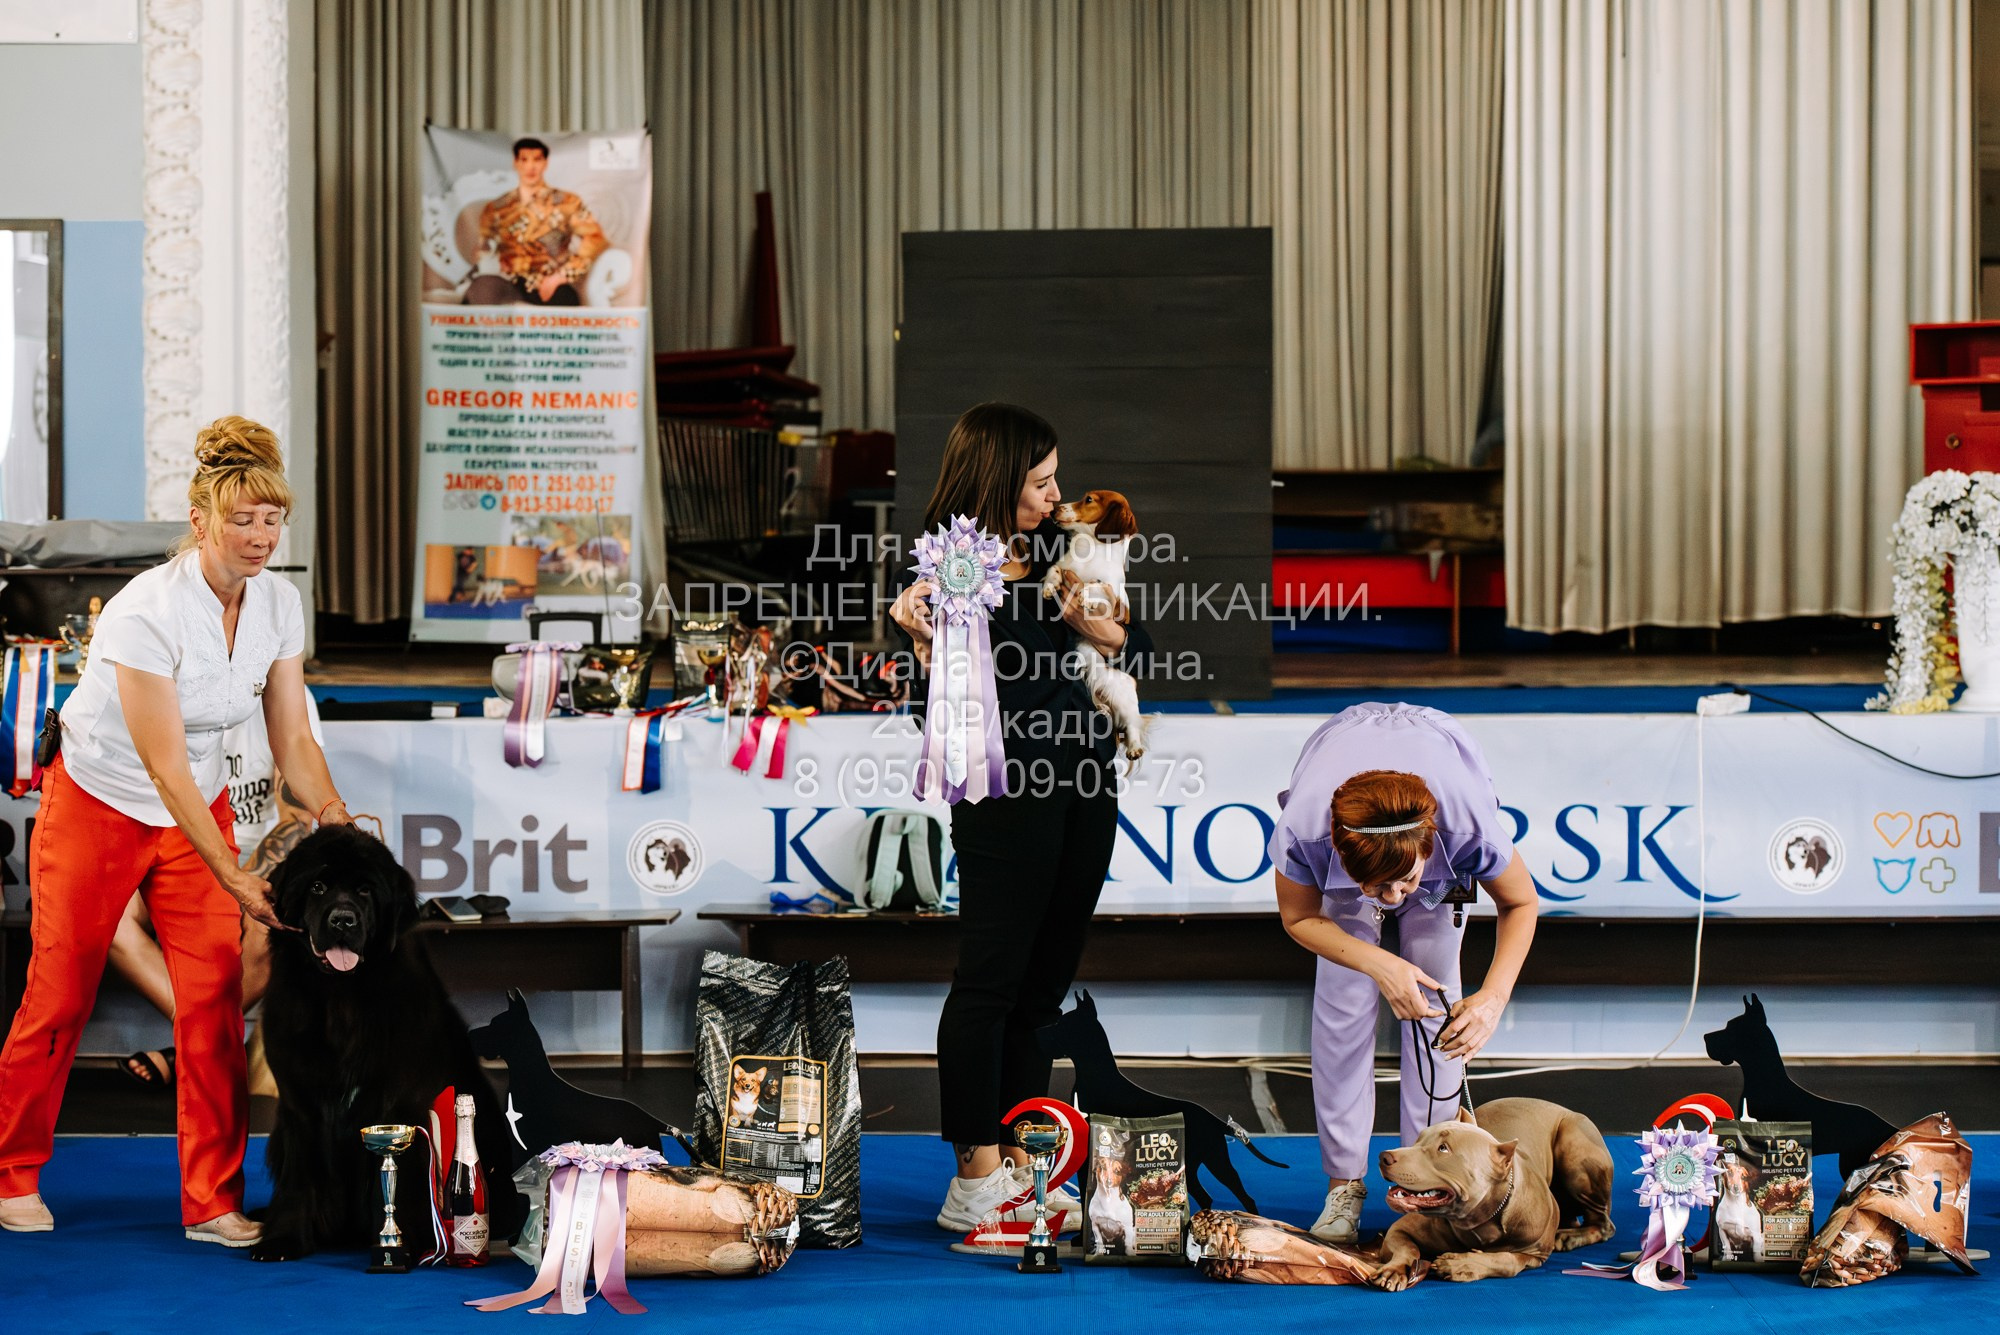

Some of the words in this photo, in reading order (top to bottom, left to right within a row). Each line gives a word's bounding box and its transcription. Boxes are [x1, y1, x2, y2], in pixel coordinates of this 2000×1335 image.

[426, 388, 523, 409] GREGOR
[532, 391, 638, 410] NEMANIC
[444, 473, 503, 490] ЗАПИСЬ
[508, 475, 527, 491] ПО
[548, 475, 615, 492] 251-03-17
[501, 496, 614, 512] 8-913-534-03-17
[402, 814, 588, 893] Brit
[1136, 1146, 1178, 1161] LUCY
[1762, 1152, 1805, 1167] LUCY
[383, 1253, 393, 1266] 1
[1034, 1251, 1046, 1266] 2
